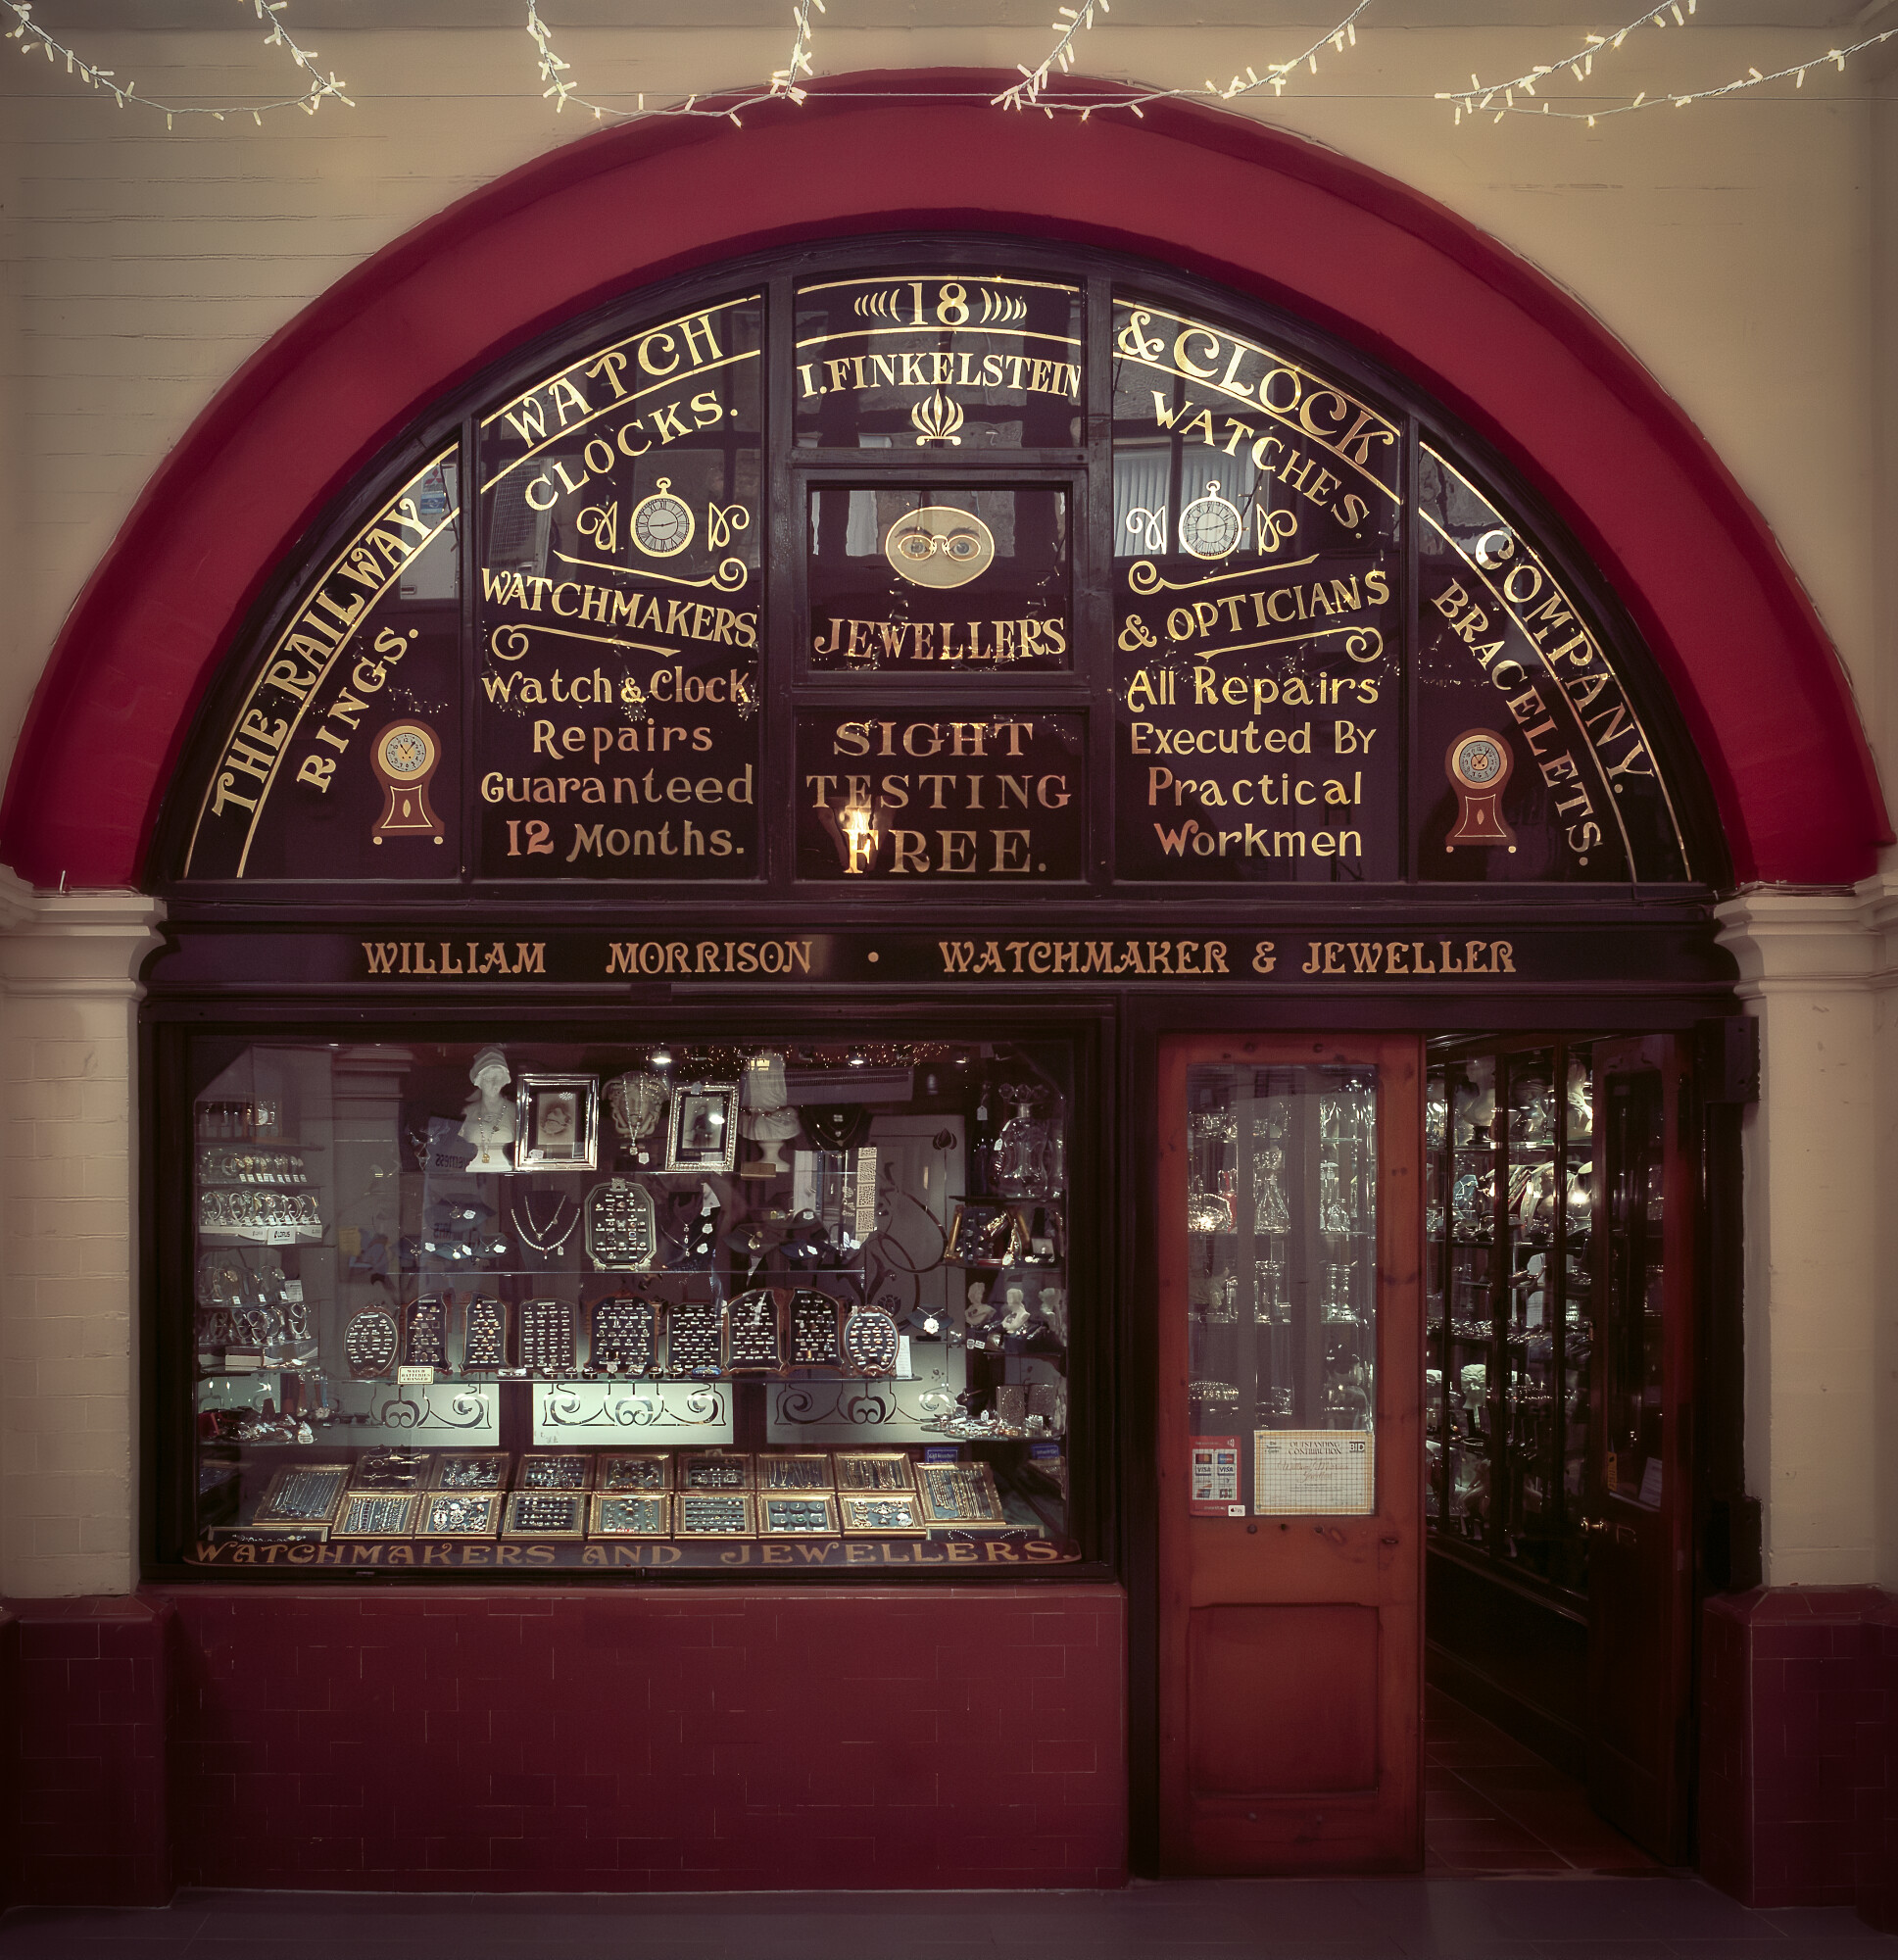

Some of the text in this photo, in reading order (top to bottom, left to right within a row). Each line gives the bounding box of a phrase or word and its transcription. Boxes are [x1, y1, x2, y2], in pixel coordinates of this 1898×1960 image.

[906, 281, 970, 327] 18
[504, 310, 1395, 466] WATCH & CLOCK
[523, 389, 740, 512] CLOCKS.
[1150, 389, 1371, 540] WATCHES.
[481, 566, 758, 649] WATCHMAKERS
[1117, 568, 1391, 653] & OPTICIANS
[212, 495, 1655, 817] THE RAILWAY COMPANY.
[813, 616, 1067, 662] JEWELLERS
[480, 664, 753, 705] Watch & Clock
[1126, 664, 1380, 715] All Repairs
[296, 624, 419, 794] RINGS.
[1431, 578, 1604, 867] BRACELETS.
[532, 718, 714, 765] Repairs
[832, 721, 1035, 759] SIGHT
[1130, 719, 1377, 756] Executed By
[480, 762, 754, 807] Guaranteed
[805, 773, 1072, 811] TESTING
[1147, 765, 1363, 807] Practical
[506, 817, 746, 863] 12 Months.
[841, 828, 1048, 875] FREE.
[1154, 819, 1363, 858] Workmen
[361, 941, 1518, 974] WILLIAM MORRISON WATCHMAKER & JEWELLER
[196, 1541, 557, 1566] WATCHMAKERS
[580, 1542, 683, 1566] AND
